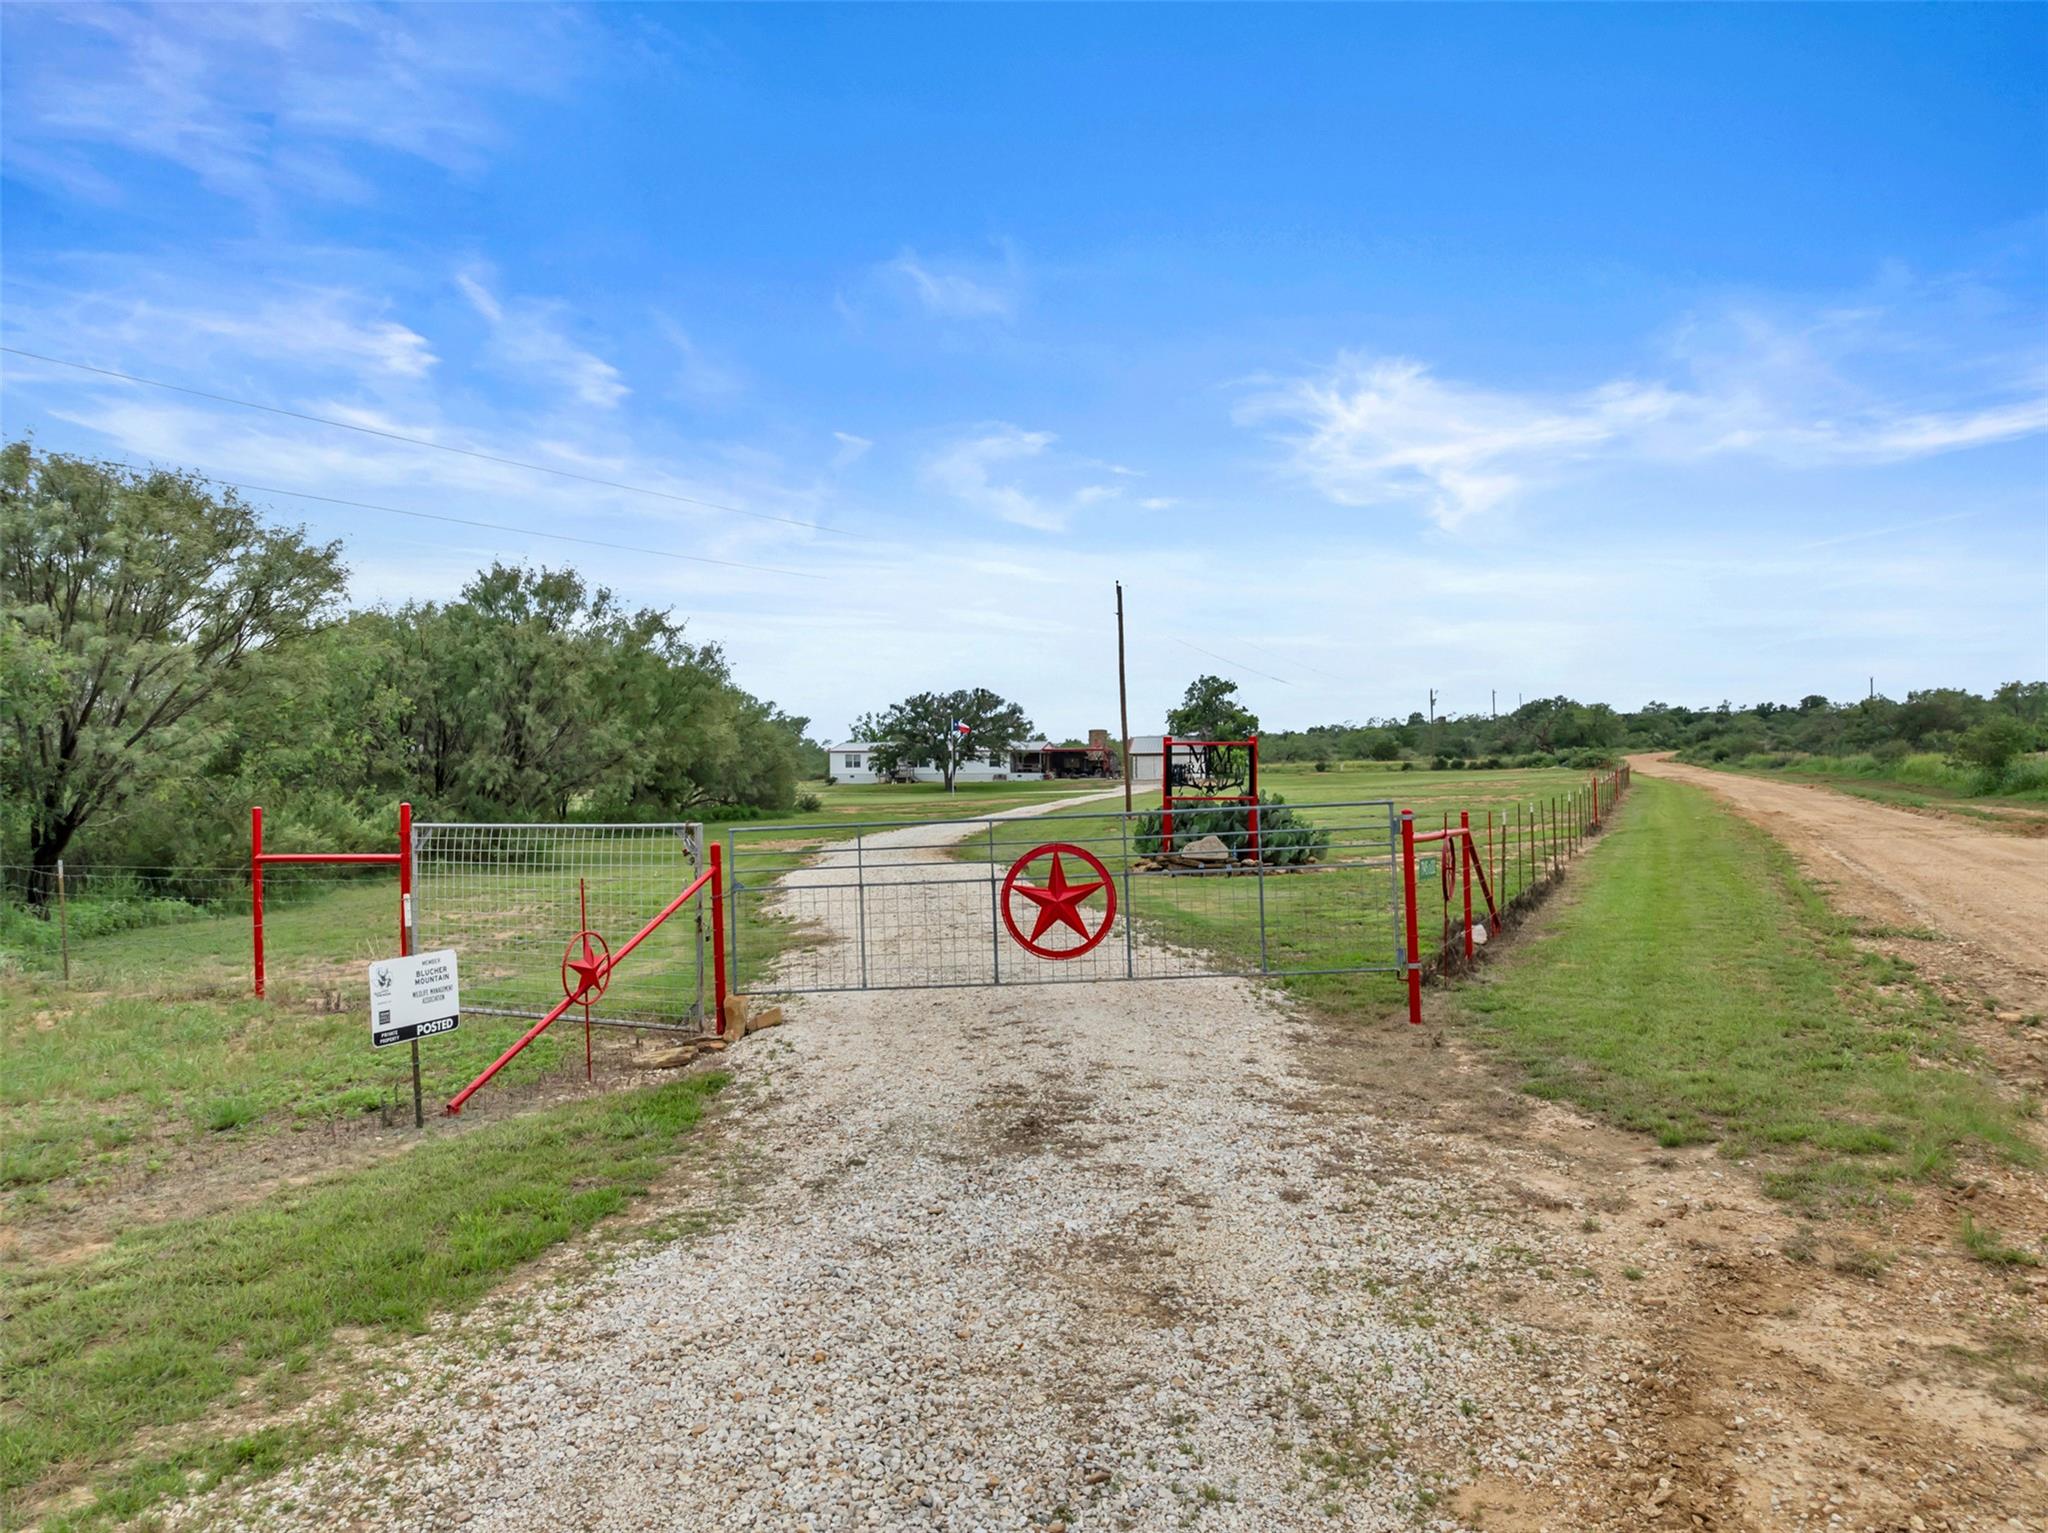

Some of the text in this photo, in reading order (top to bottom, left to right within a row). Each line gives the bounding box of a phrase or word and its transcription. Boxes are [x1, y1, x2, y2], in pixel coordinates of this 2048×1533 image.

[416, 966, 447, 977] BLUCHER
[415, 973, 449, 985] MOUNTAIN
[417, 1018, 453, 1035] POSTED
